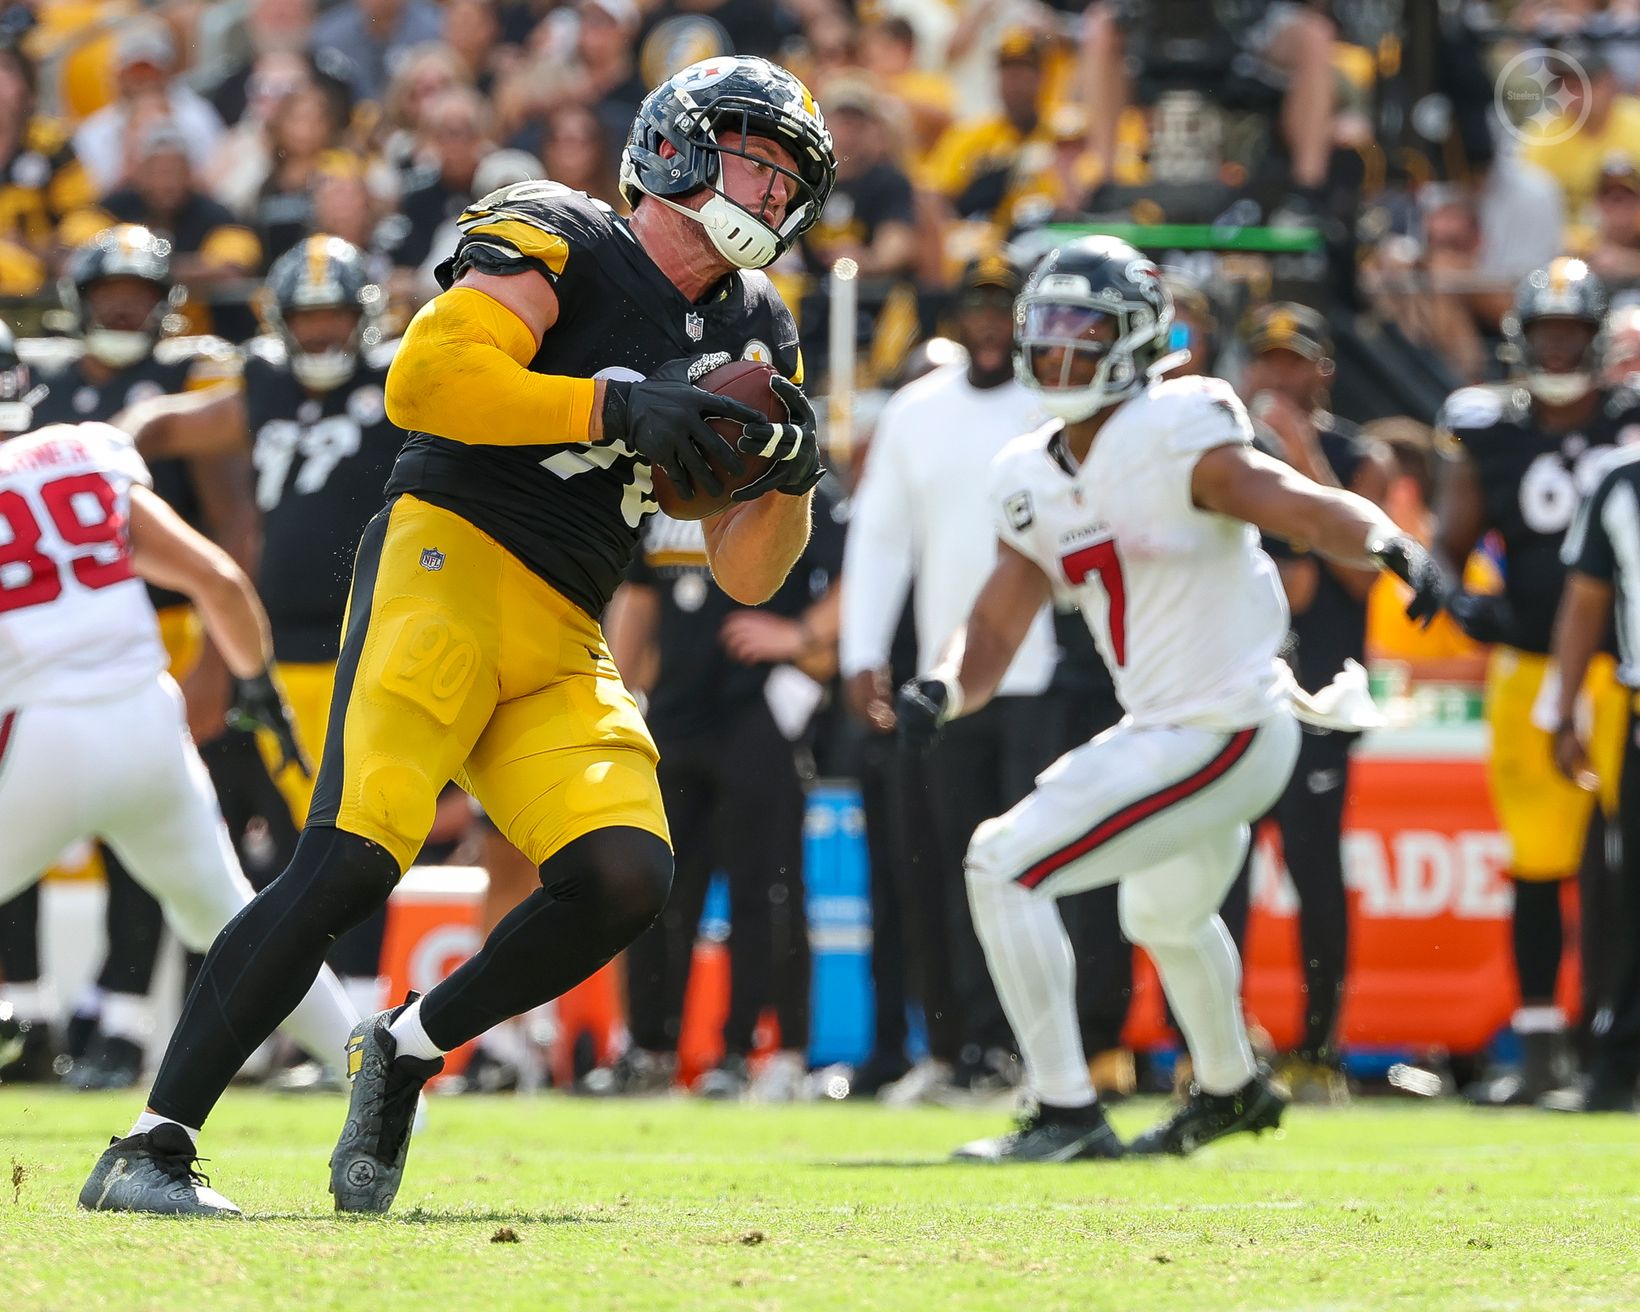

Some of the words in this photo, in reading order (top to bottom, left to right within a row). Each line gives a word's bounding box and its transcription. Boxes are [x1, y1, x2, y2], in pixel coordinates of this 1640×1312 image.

[0, 472, 140, 612] 89
[1063, 538, 1126, 667] 7
[396, 620, 475, 700] 90
